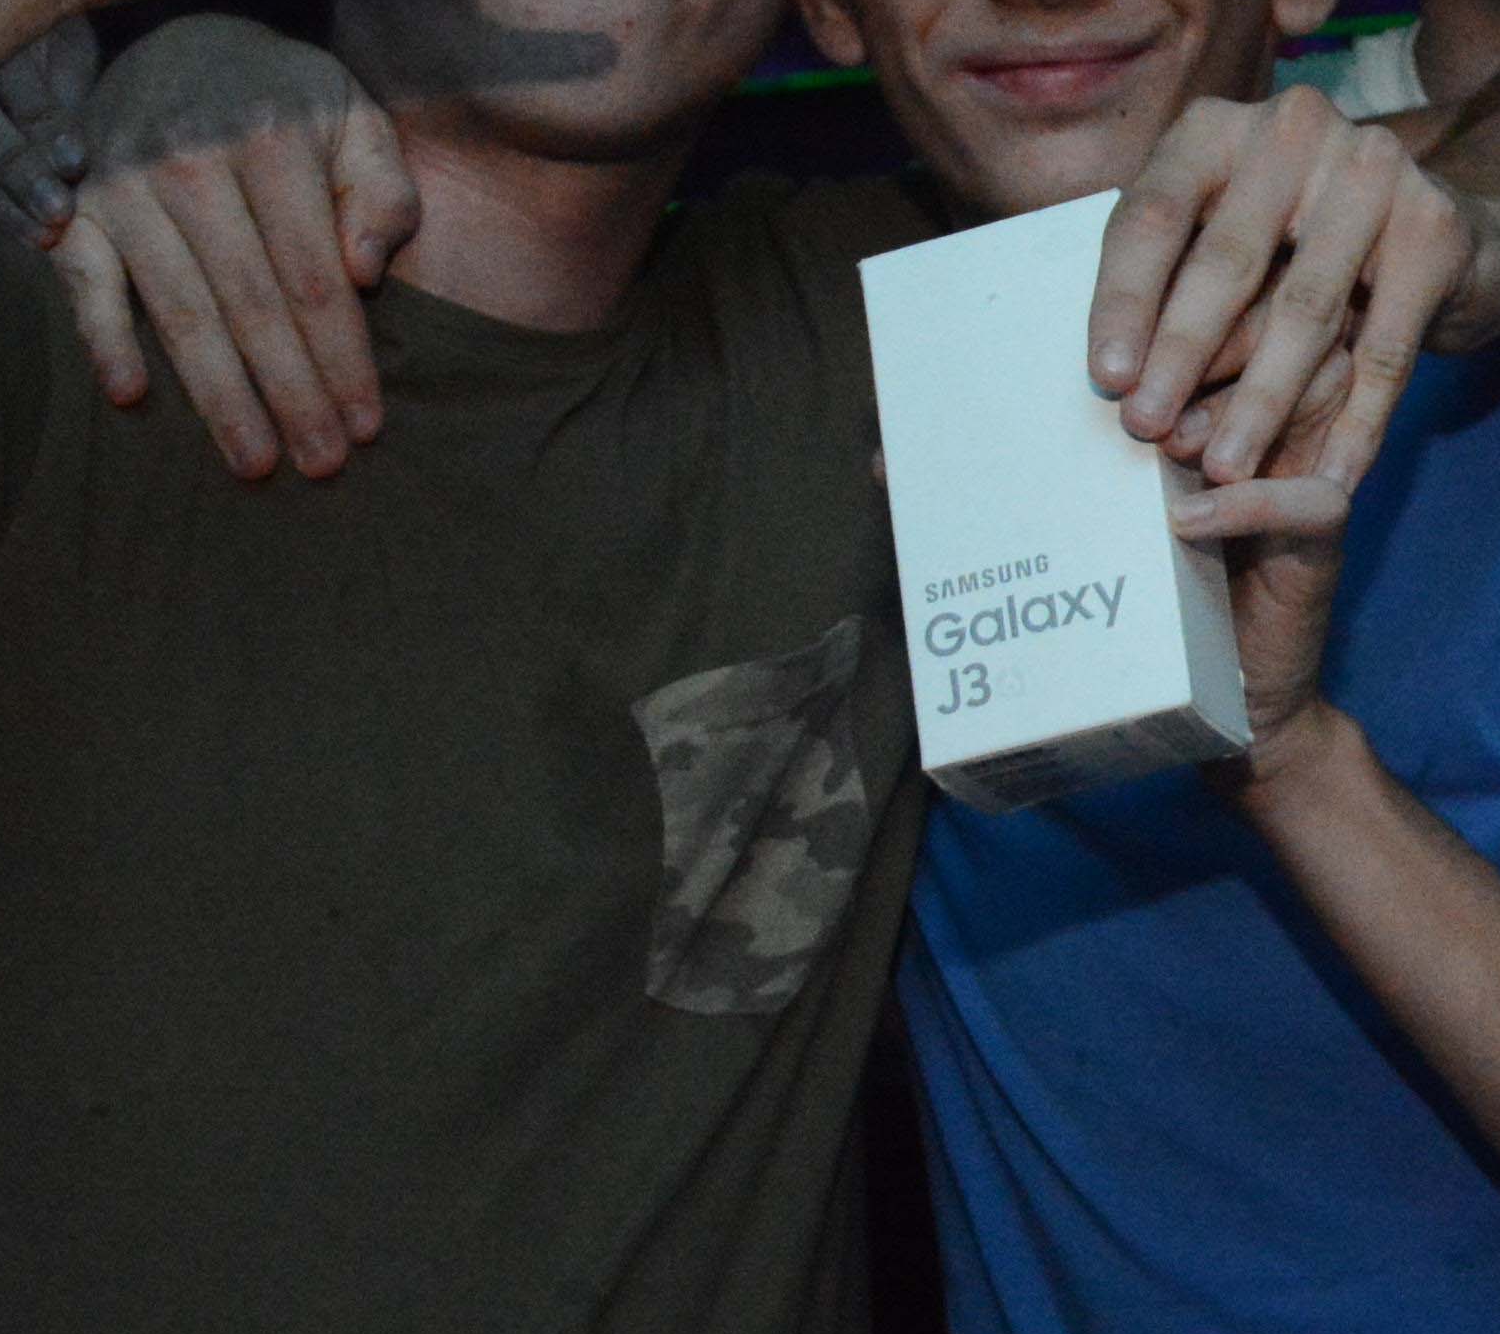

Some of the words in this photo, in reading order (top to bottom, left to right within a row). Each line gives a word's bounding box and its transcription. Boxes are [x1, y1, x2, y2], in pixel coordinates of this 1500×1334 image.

[924, 553, 1051, 604] SAMSUNG
[924, 574, 1127, 658] Galaxy
[936, 662, 993, 716] J3
